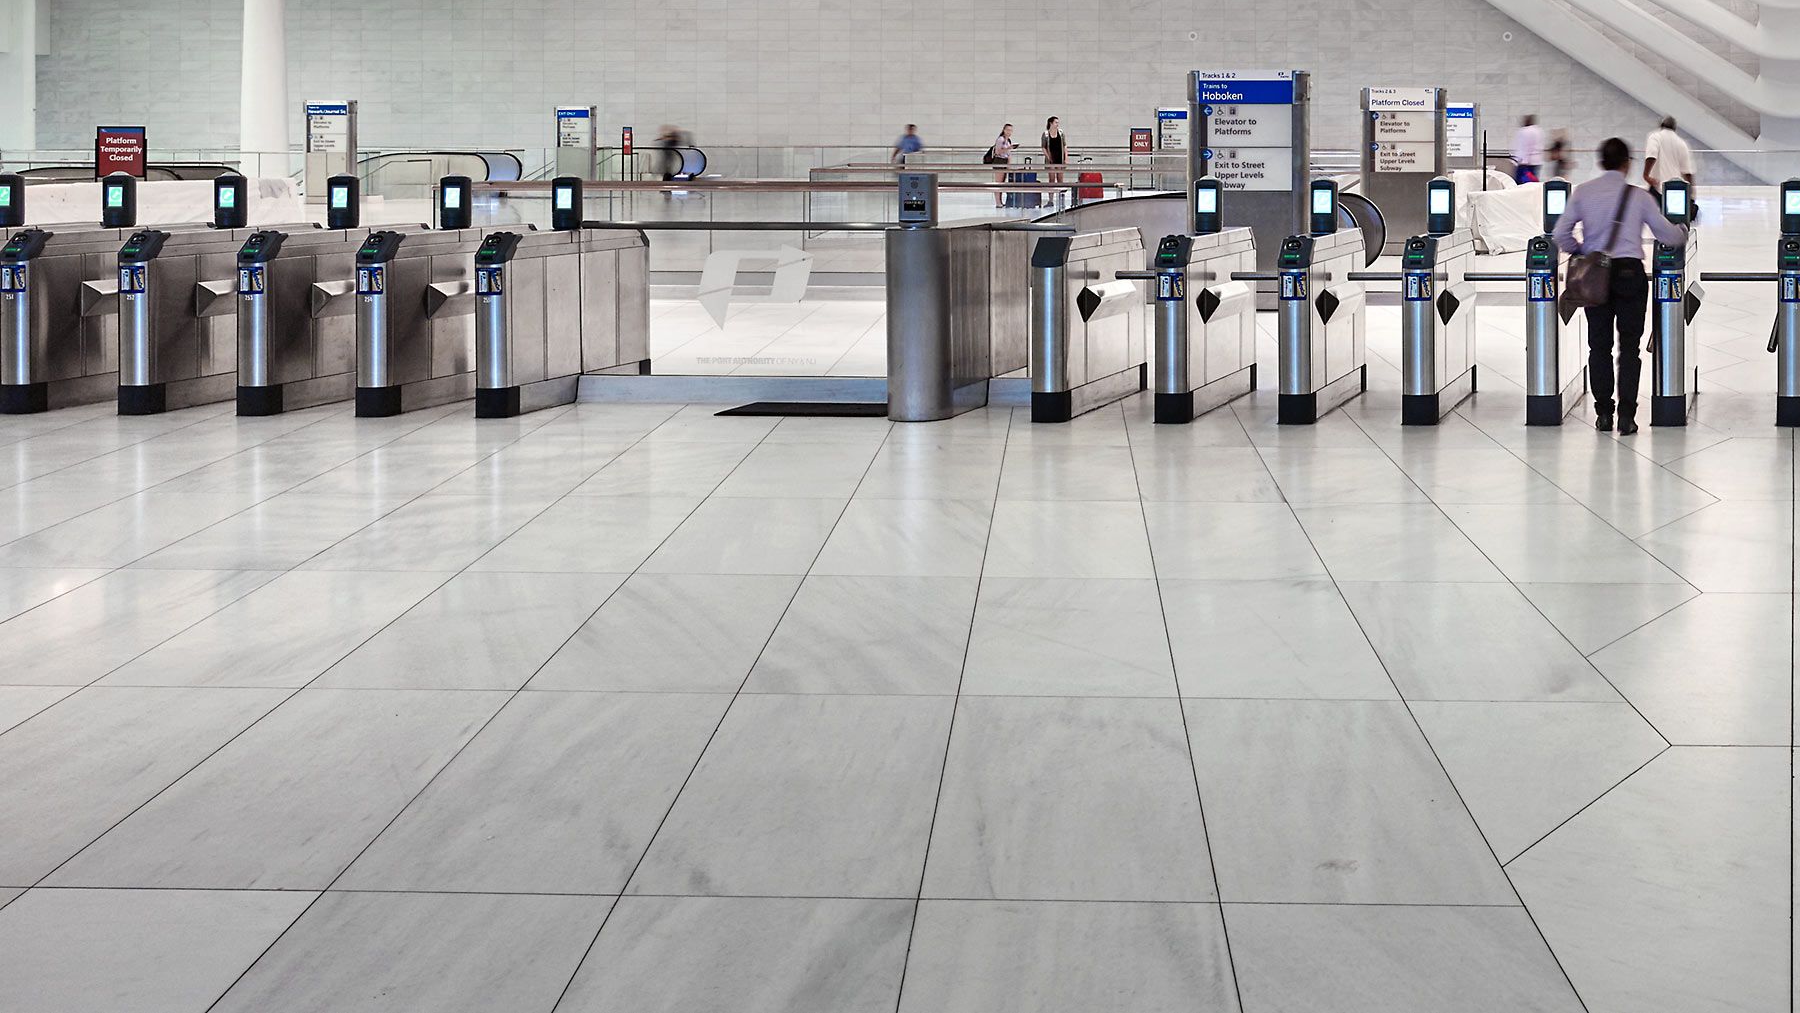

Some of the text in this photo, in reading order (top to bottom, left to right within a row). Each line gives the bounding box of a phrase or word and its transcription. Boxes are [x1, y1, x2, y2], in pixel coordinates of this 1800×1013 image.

[1202, 91, 1243, 100] Hoboken
[100, 146, 142, 154] Temporarily
[1215, 161, 1229, 169] Exit
[1242, 161, 1265, 169] Street
[1215, 172, 1238, 180] Upper
[1222, 182, 1246, 190] bway
[733, 357, 775, 365] AUTHORITY
